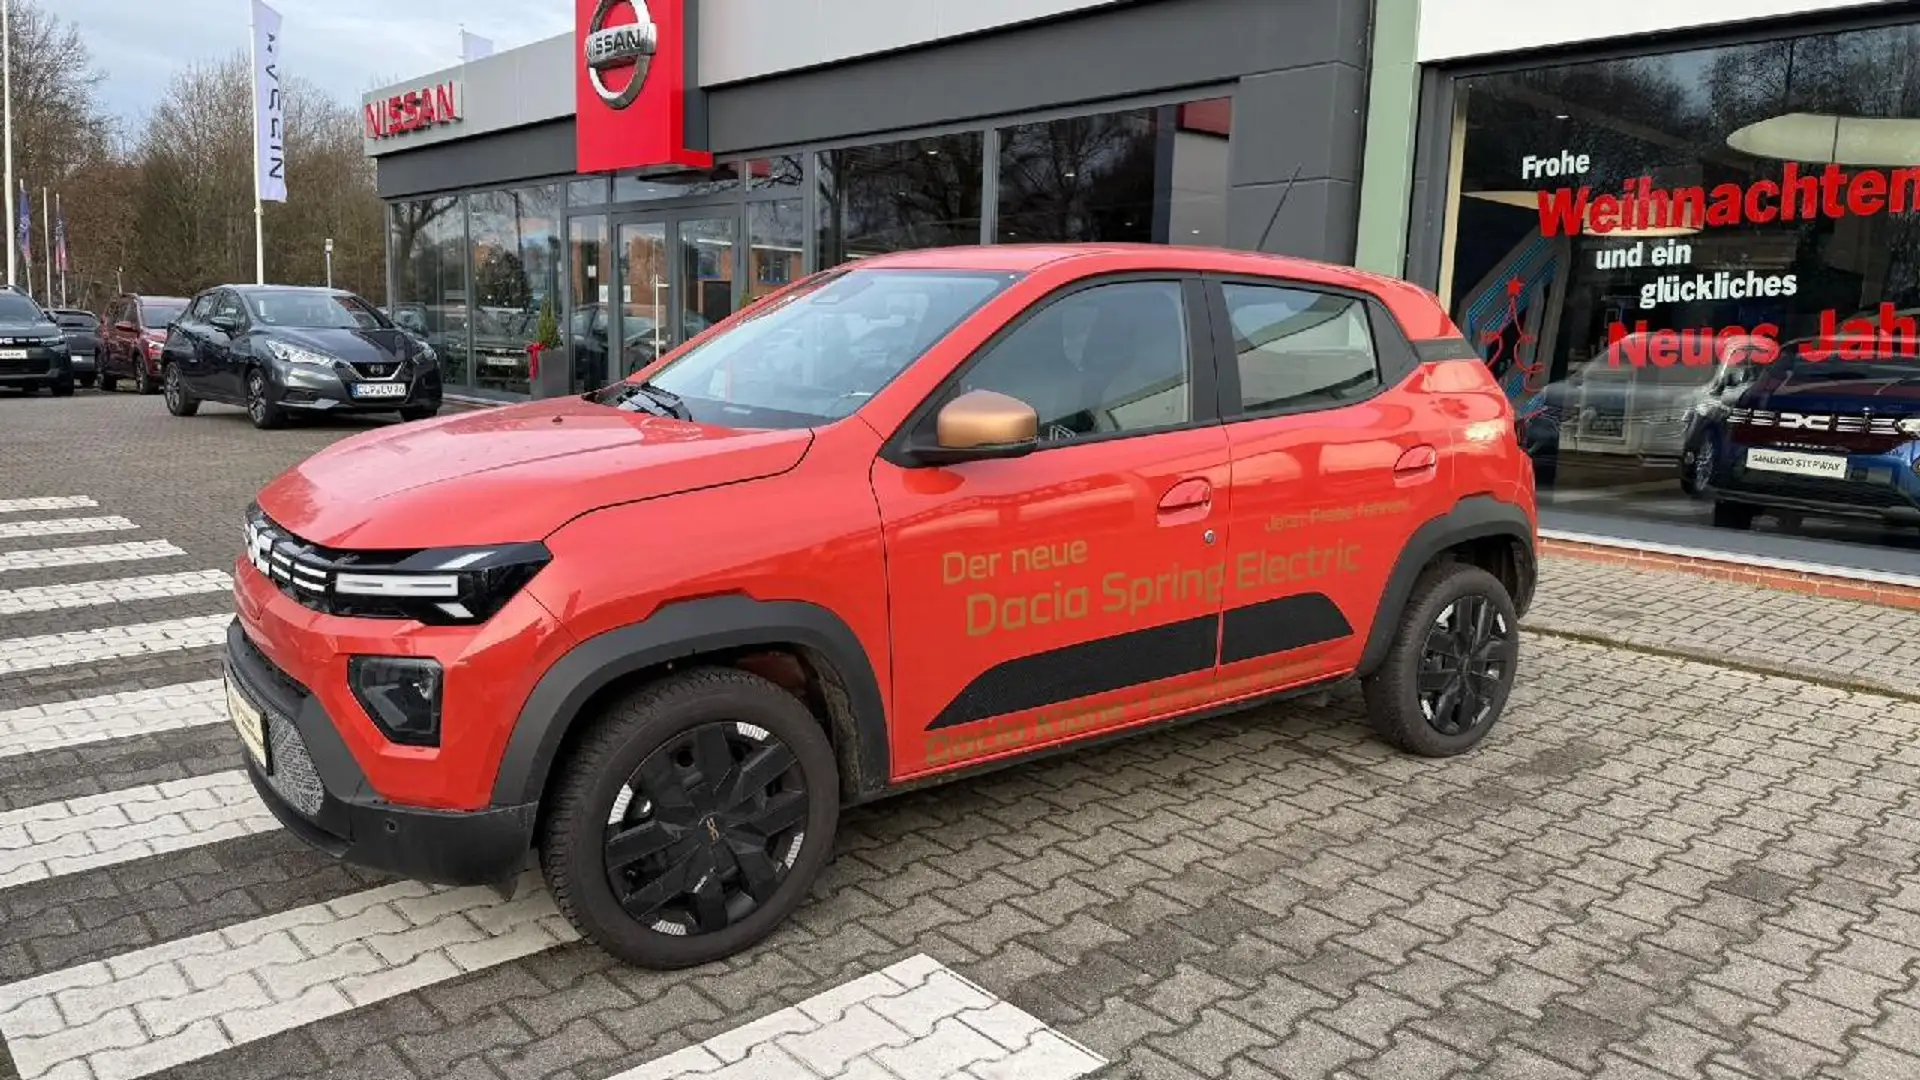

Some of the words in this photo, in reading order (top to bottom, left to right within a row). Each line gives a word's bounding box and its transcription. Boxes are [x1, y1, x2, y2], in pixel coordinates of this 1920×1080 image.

[586, 29, 641, 57] NISSAN
[365, 82, 457, 139] NISSAN
[1522, 150, 1590, 179] Frohe
[1537, 162, 1920, 237] Weihnachten
[1596, 241, 1643, 269] und
[1651, 239, 1691, 267] ein
[1639, 270, 1797, 309] glückliches
[1608, 320, 1780, 369] Neues
[942, 550, 1001, 585] Der
[1012, 539, 1089, 573] neue
[966, 581, 1089, 637] Dacia
[1102, 563, 1226, 616] Spring
[1236, 538, 1362, 590] Electric
